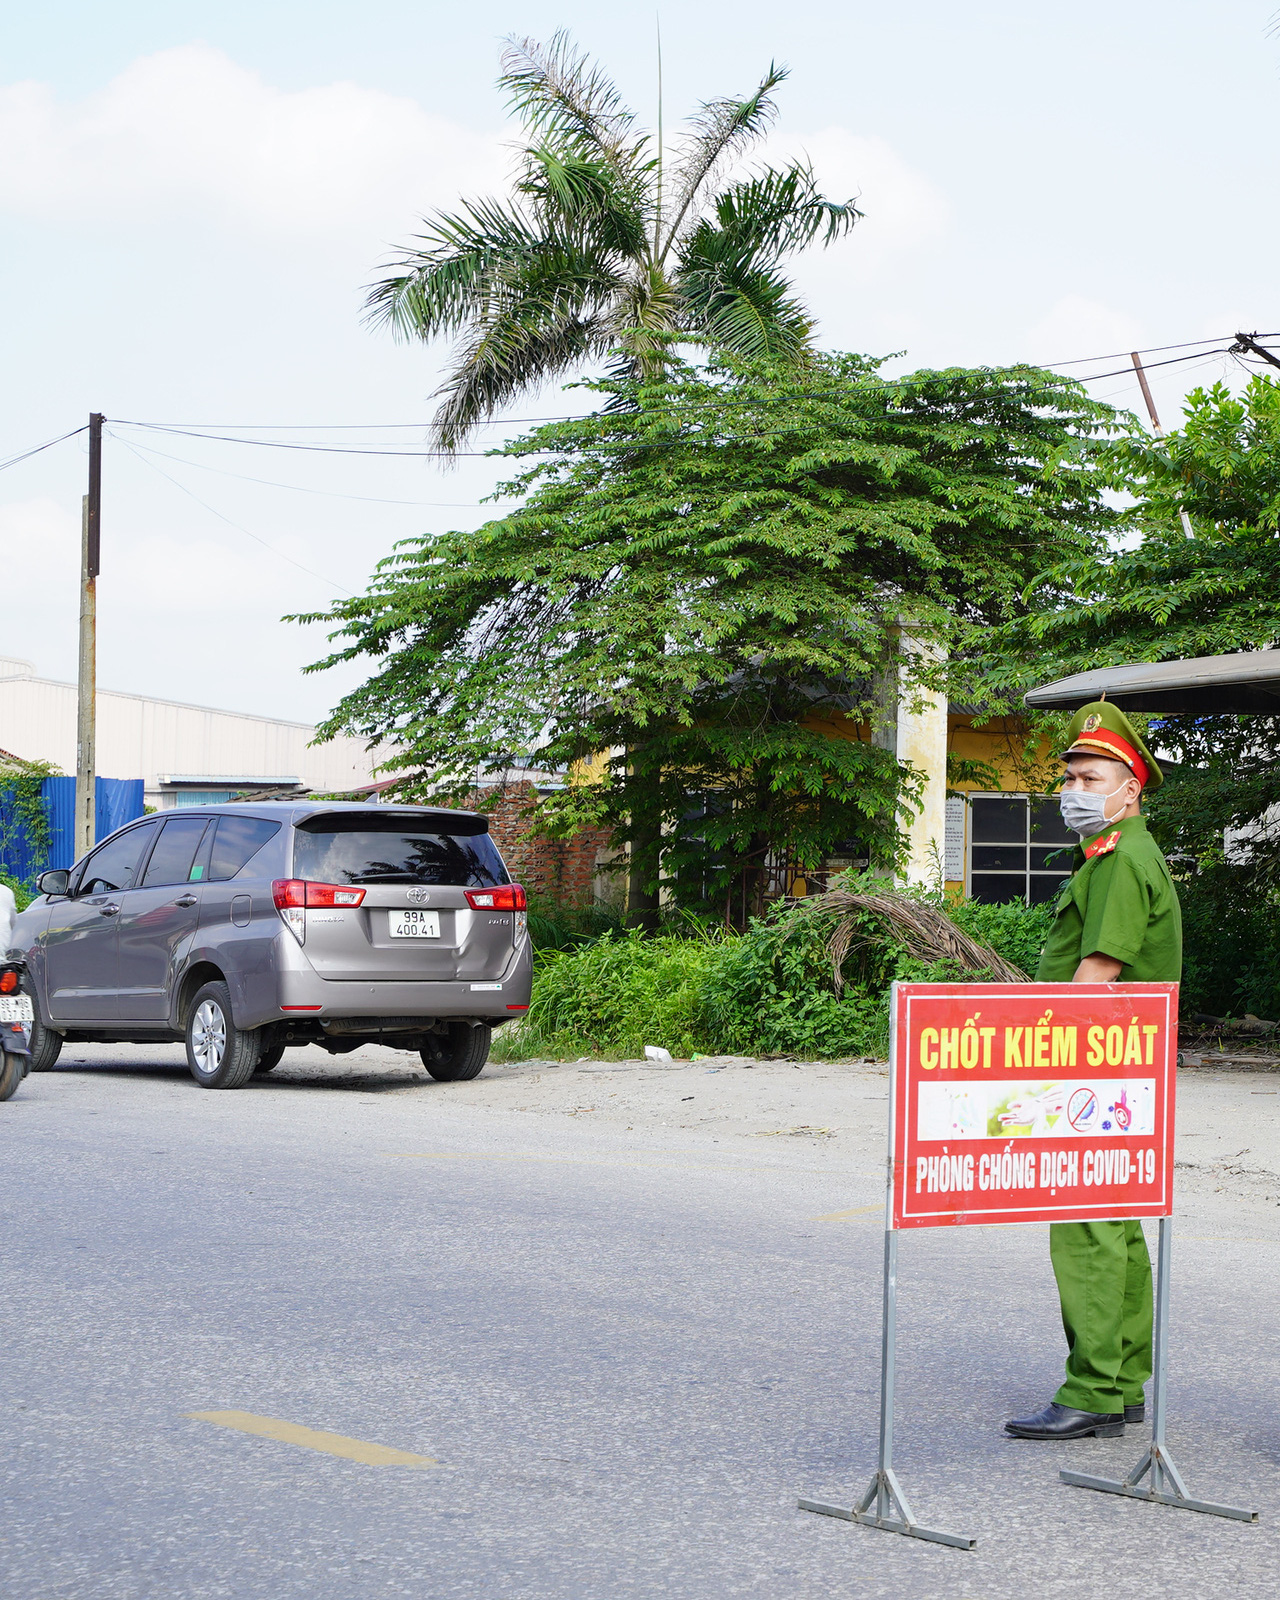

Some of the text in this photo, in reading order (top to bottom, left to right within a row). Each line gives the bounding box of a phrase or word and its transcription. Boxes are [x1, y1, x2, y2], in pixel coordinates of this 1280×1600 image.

[396, 924, 434, 936] 400.41
[404, 911, 425, 923] 99A
[919, 1008, 1159, 1071] CHỐT KIỂM SOÁT
[915, 1140, 1156, 1196] PHÒNG CHỐNG DỊCH COVID-19
